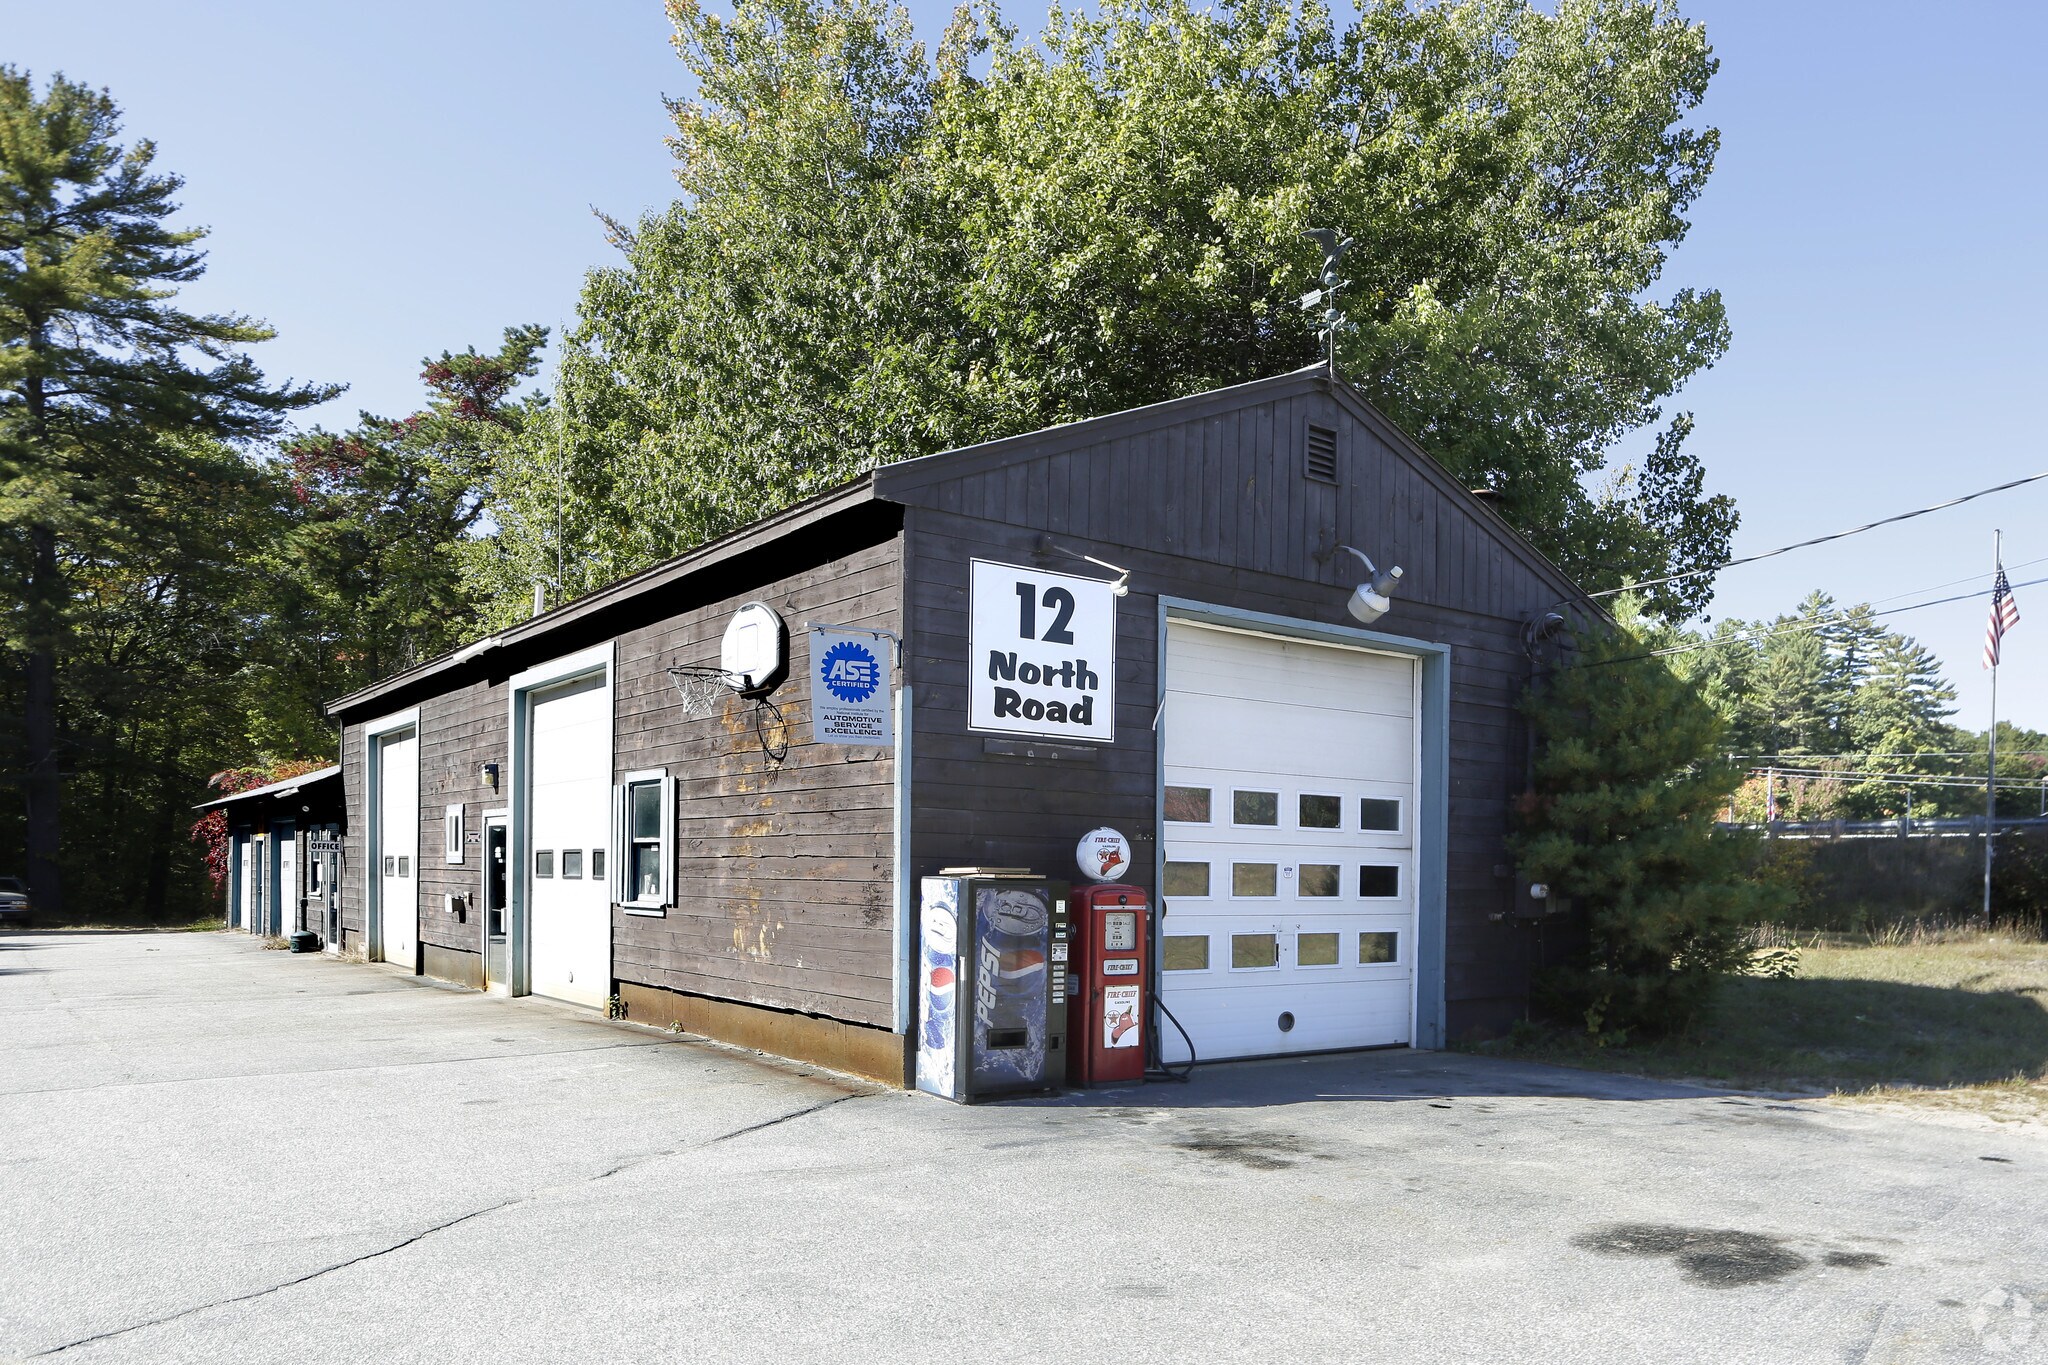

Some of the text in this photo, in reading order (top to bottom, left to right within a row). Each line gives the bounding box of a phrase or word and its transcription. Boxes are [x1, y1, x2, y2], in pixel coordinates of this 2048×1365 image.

[1015, 581, 1075, 645] 12
[828, 659, 870, 681] ASE
[988, 650, 1098, 690] North
[832, 680, 870, 688] CERTIFIED
[994, 686, 1093, 725] Road
[823, 715, 882, 723] AUTOMOTIVE
[834, 721, 873, 729] SERVICE
[824, 728, 883, 736] EXCELLENCE
[976, 936, 1001, 1028] PEPSI
